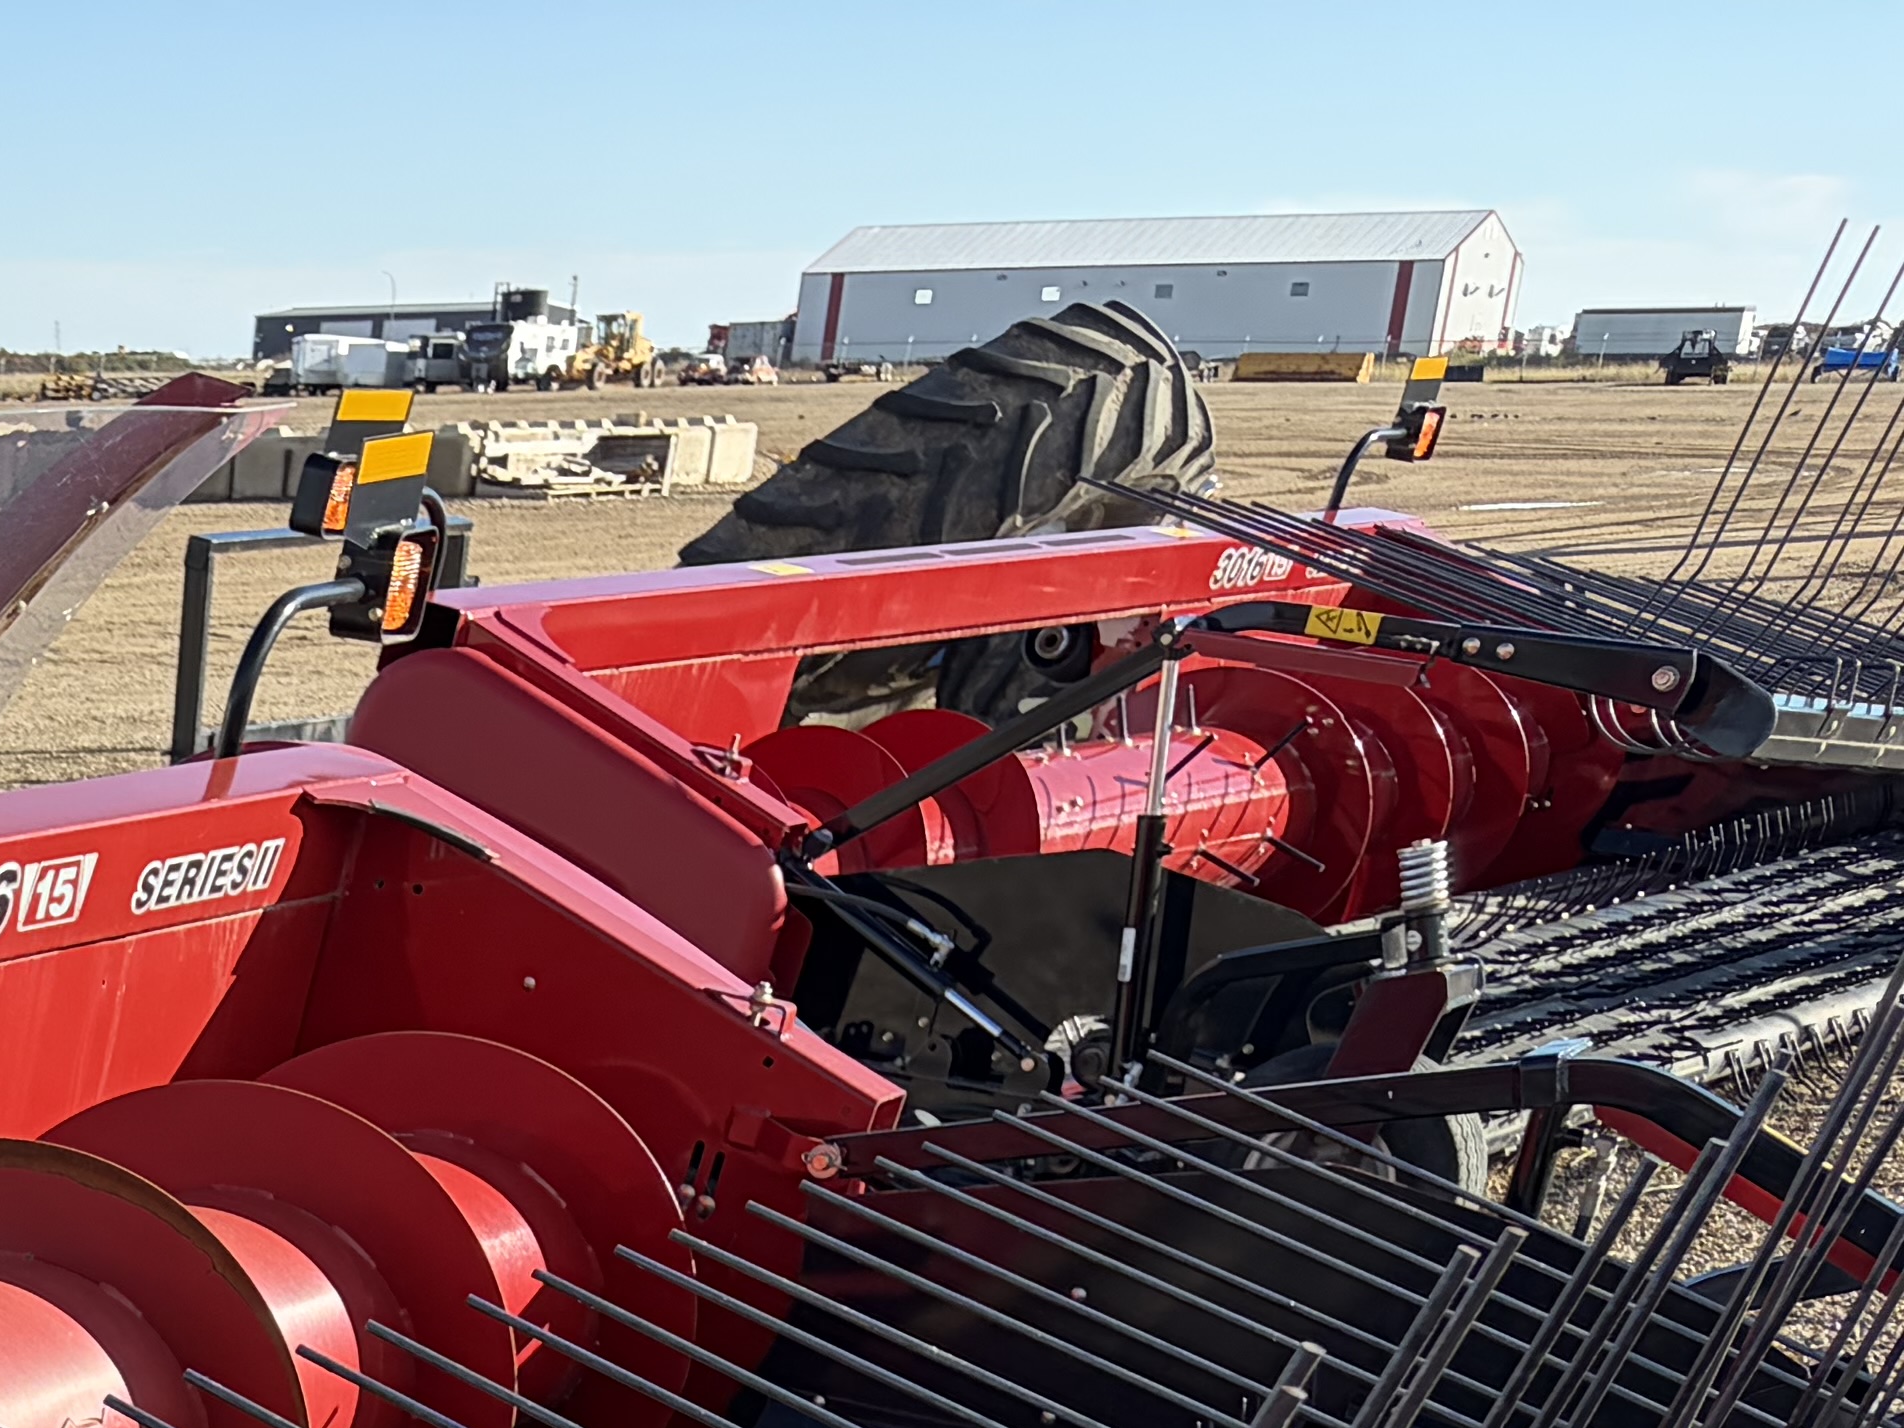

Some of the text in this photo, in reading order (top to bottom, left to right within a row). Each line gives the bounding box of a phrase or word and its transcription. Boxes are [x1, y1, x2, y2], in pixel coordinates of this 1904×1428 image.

[1209, 546, 1265, 590] 3016
[33, 864, 89, 922] 15
[131, 837, 286, 915] SERIES II
